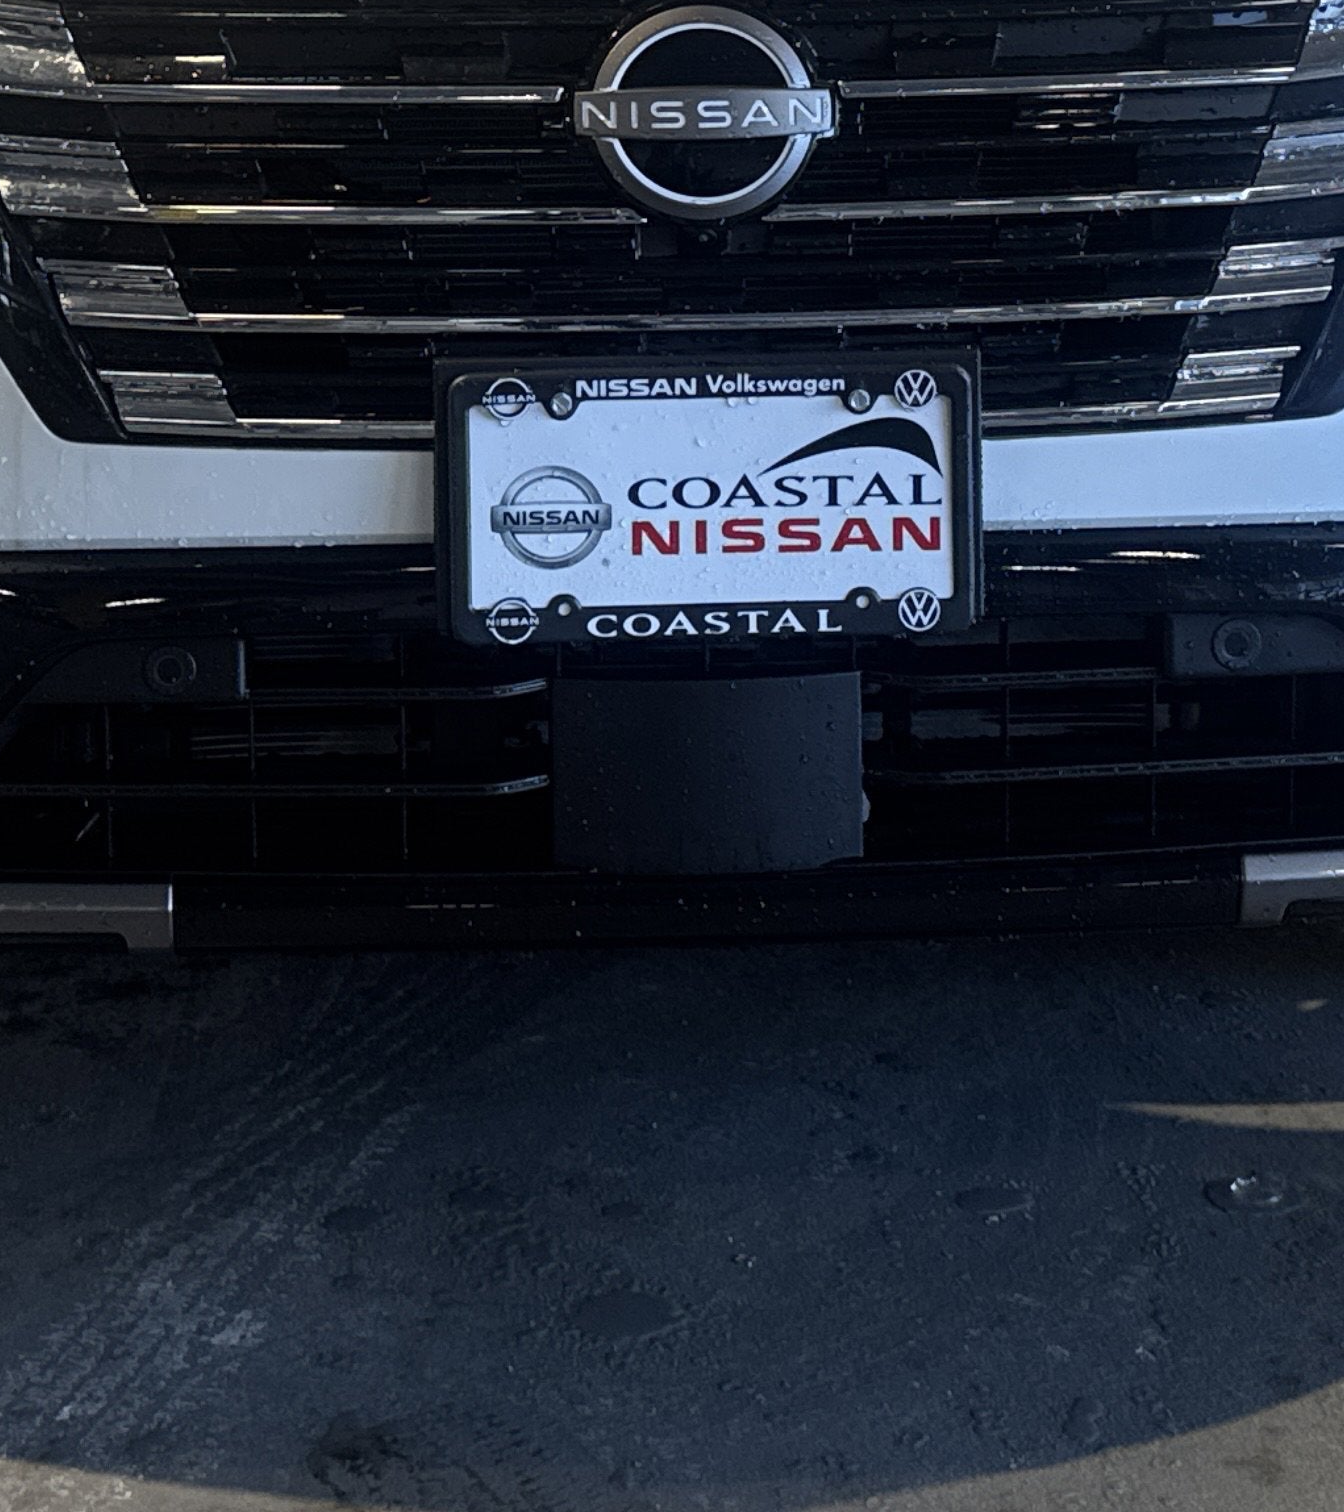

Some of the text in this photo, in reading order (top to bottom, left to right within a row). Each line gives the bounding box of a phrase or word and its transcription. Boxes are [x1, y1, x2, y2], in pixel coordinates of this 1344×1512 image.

[581, 97, 823, 130] NISSAN
[482, 393, 536, 405] NISSAN
[575, 373, 846, 399] NISSAN Volkswagen
[627, 471, 943, 510] COASTAL
[503, 509, 600, 526] NISSAN
[631, 516, 942, 556] NISSAN
[485, 616, 540, 628] NISSAN
[586, 607, 843, 638] COASTAL
